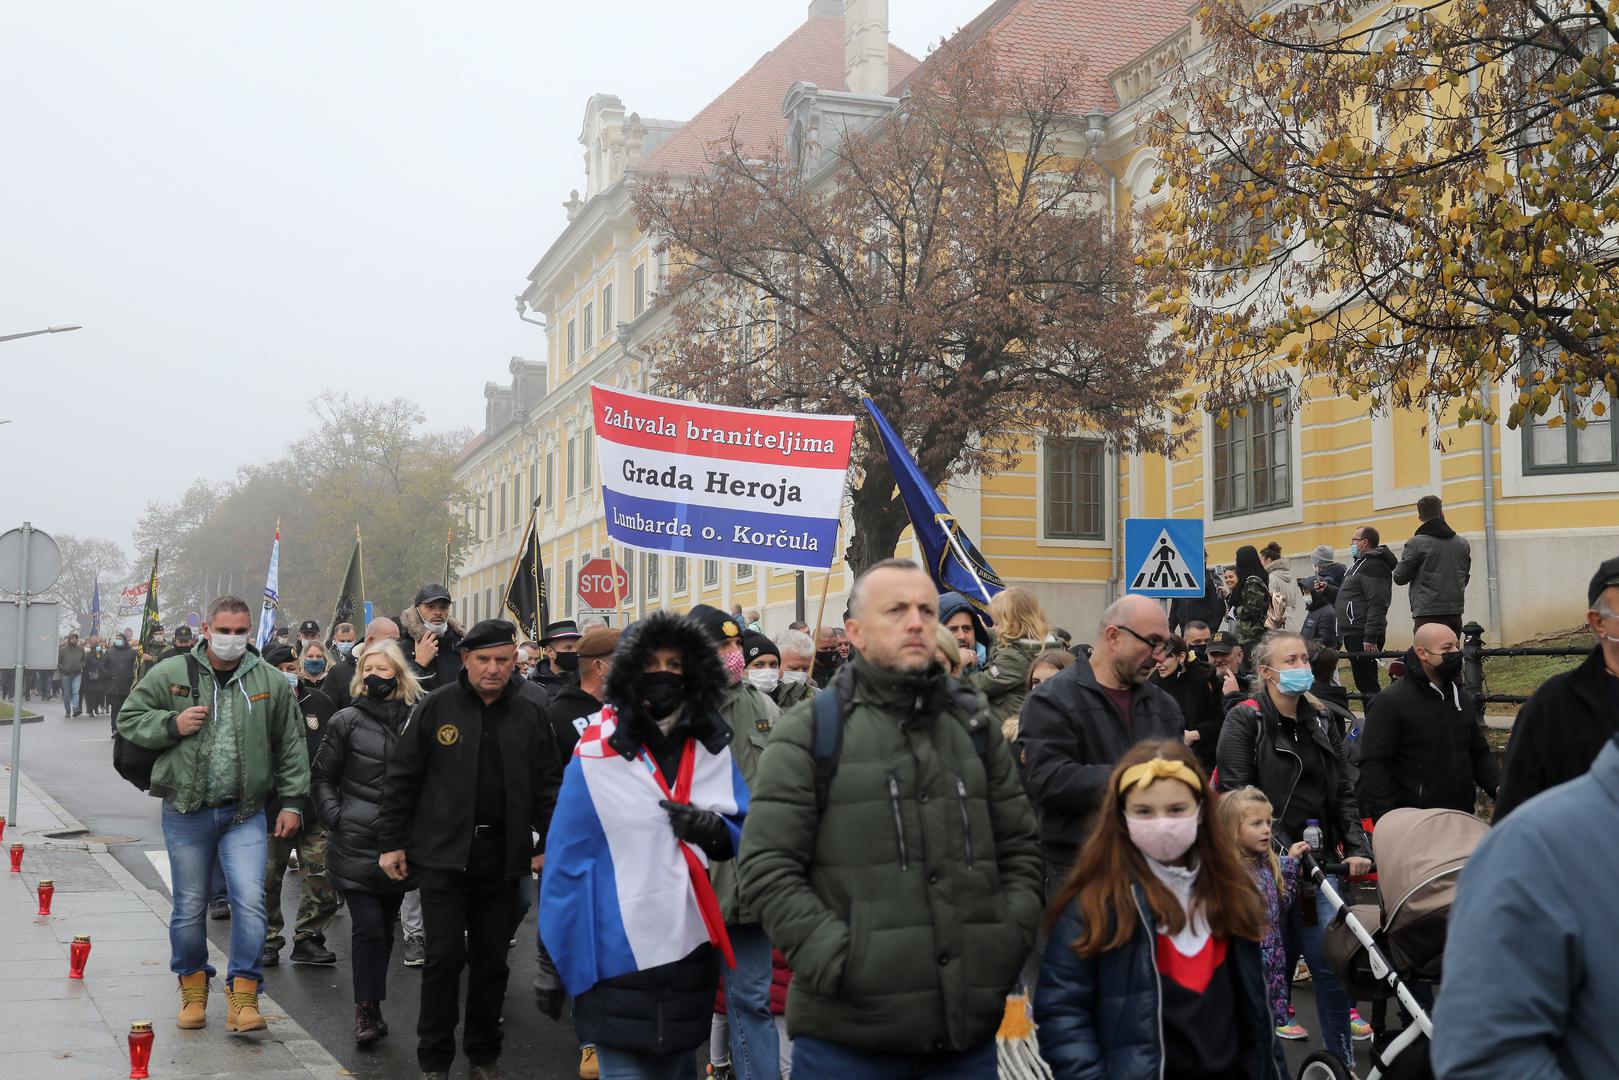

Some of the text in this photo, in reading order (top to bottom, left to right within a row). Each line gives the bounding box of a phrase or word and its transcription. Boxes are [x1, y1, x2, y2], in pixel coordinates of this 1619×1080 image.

[604, 405, 835, 455] Zahvala braniteljima
[622, 459, 802, 507] Grada Heroja
[613, 506, 819, 552] Lumbarda o. Korčula
[581, 575, 625, 593] STOP
